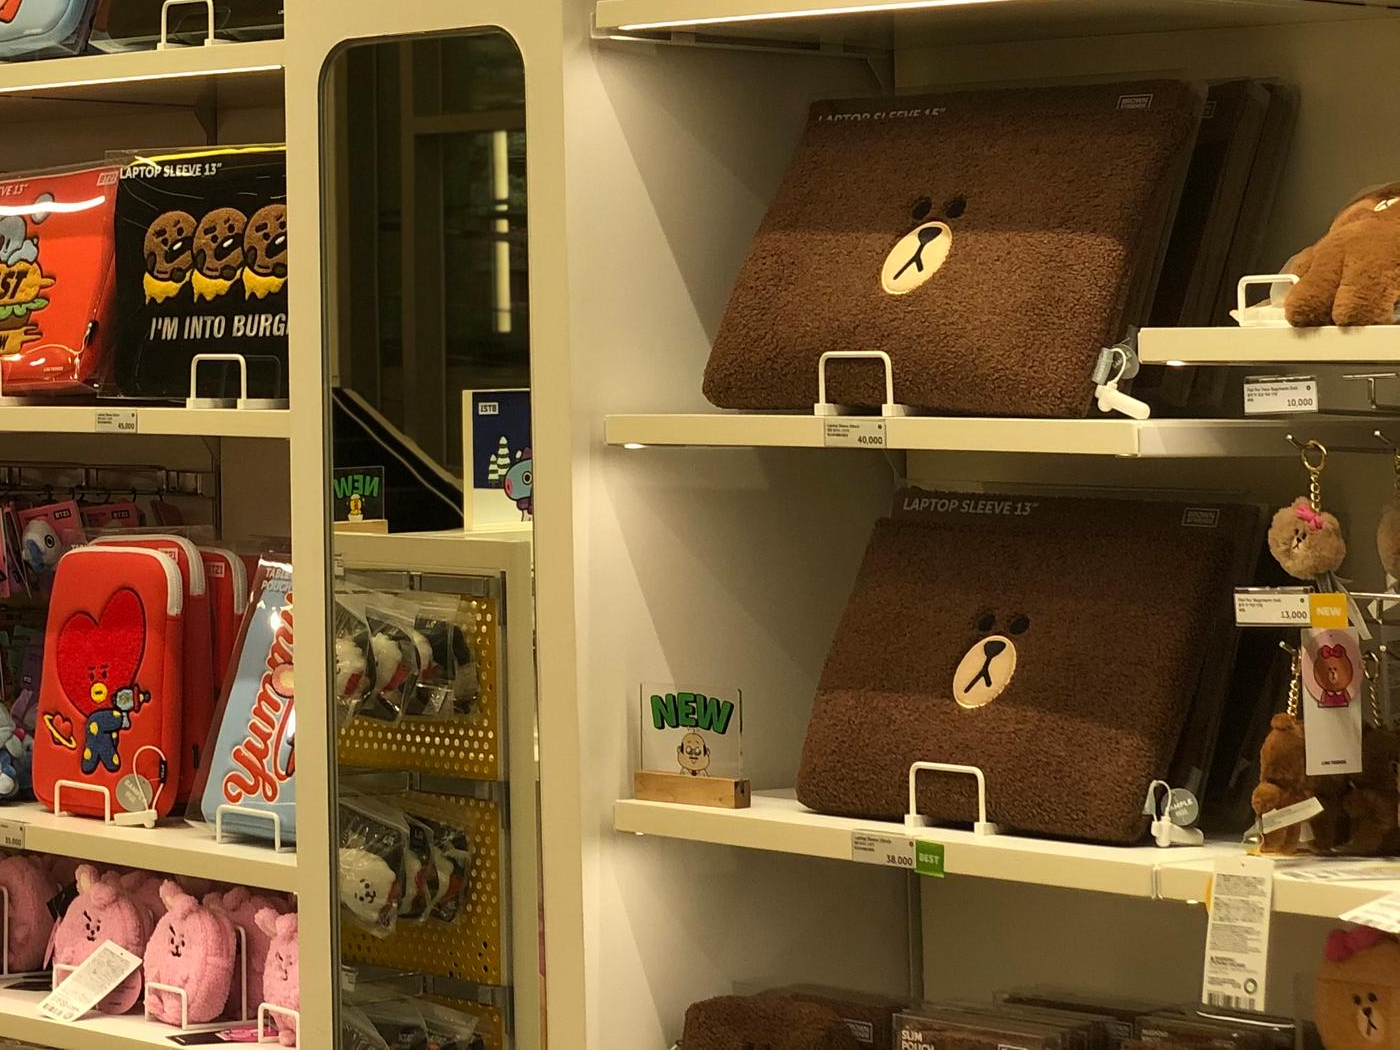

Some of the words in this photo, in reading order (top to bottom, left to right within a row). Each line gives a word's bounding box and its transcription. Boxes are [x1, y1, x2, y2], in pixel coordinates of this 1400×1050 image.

[120, 166, 161, 179] LAPTOP
[163, 164, 202, 177] SLEEVE
[150, 317, 178, 341] I'M
[183, 315, 226, 339] INTO
[232, 313, 289, 338] BURG
[1287, 398, 1313, 408] 10,000
[857, 436, 883, 446] 40,000
[903, 497, 959, 512] LAPTOP
[961, 500, 1012, 515] SLEEVE
[1281, 610, 1307, 619] 13,000
[1316, 606, 1342, 617] NEW
[650, 692, 734, 735] NEW
[886, 854, 913, 866] 38,000
[918, 852, 940, 865] BEST
[902, 1030, 922, 1042] SLIM
